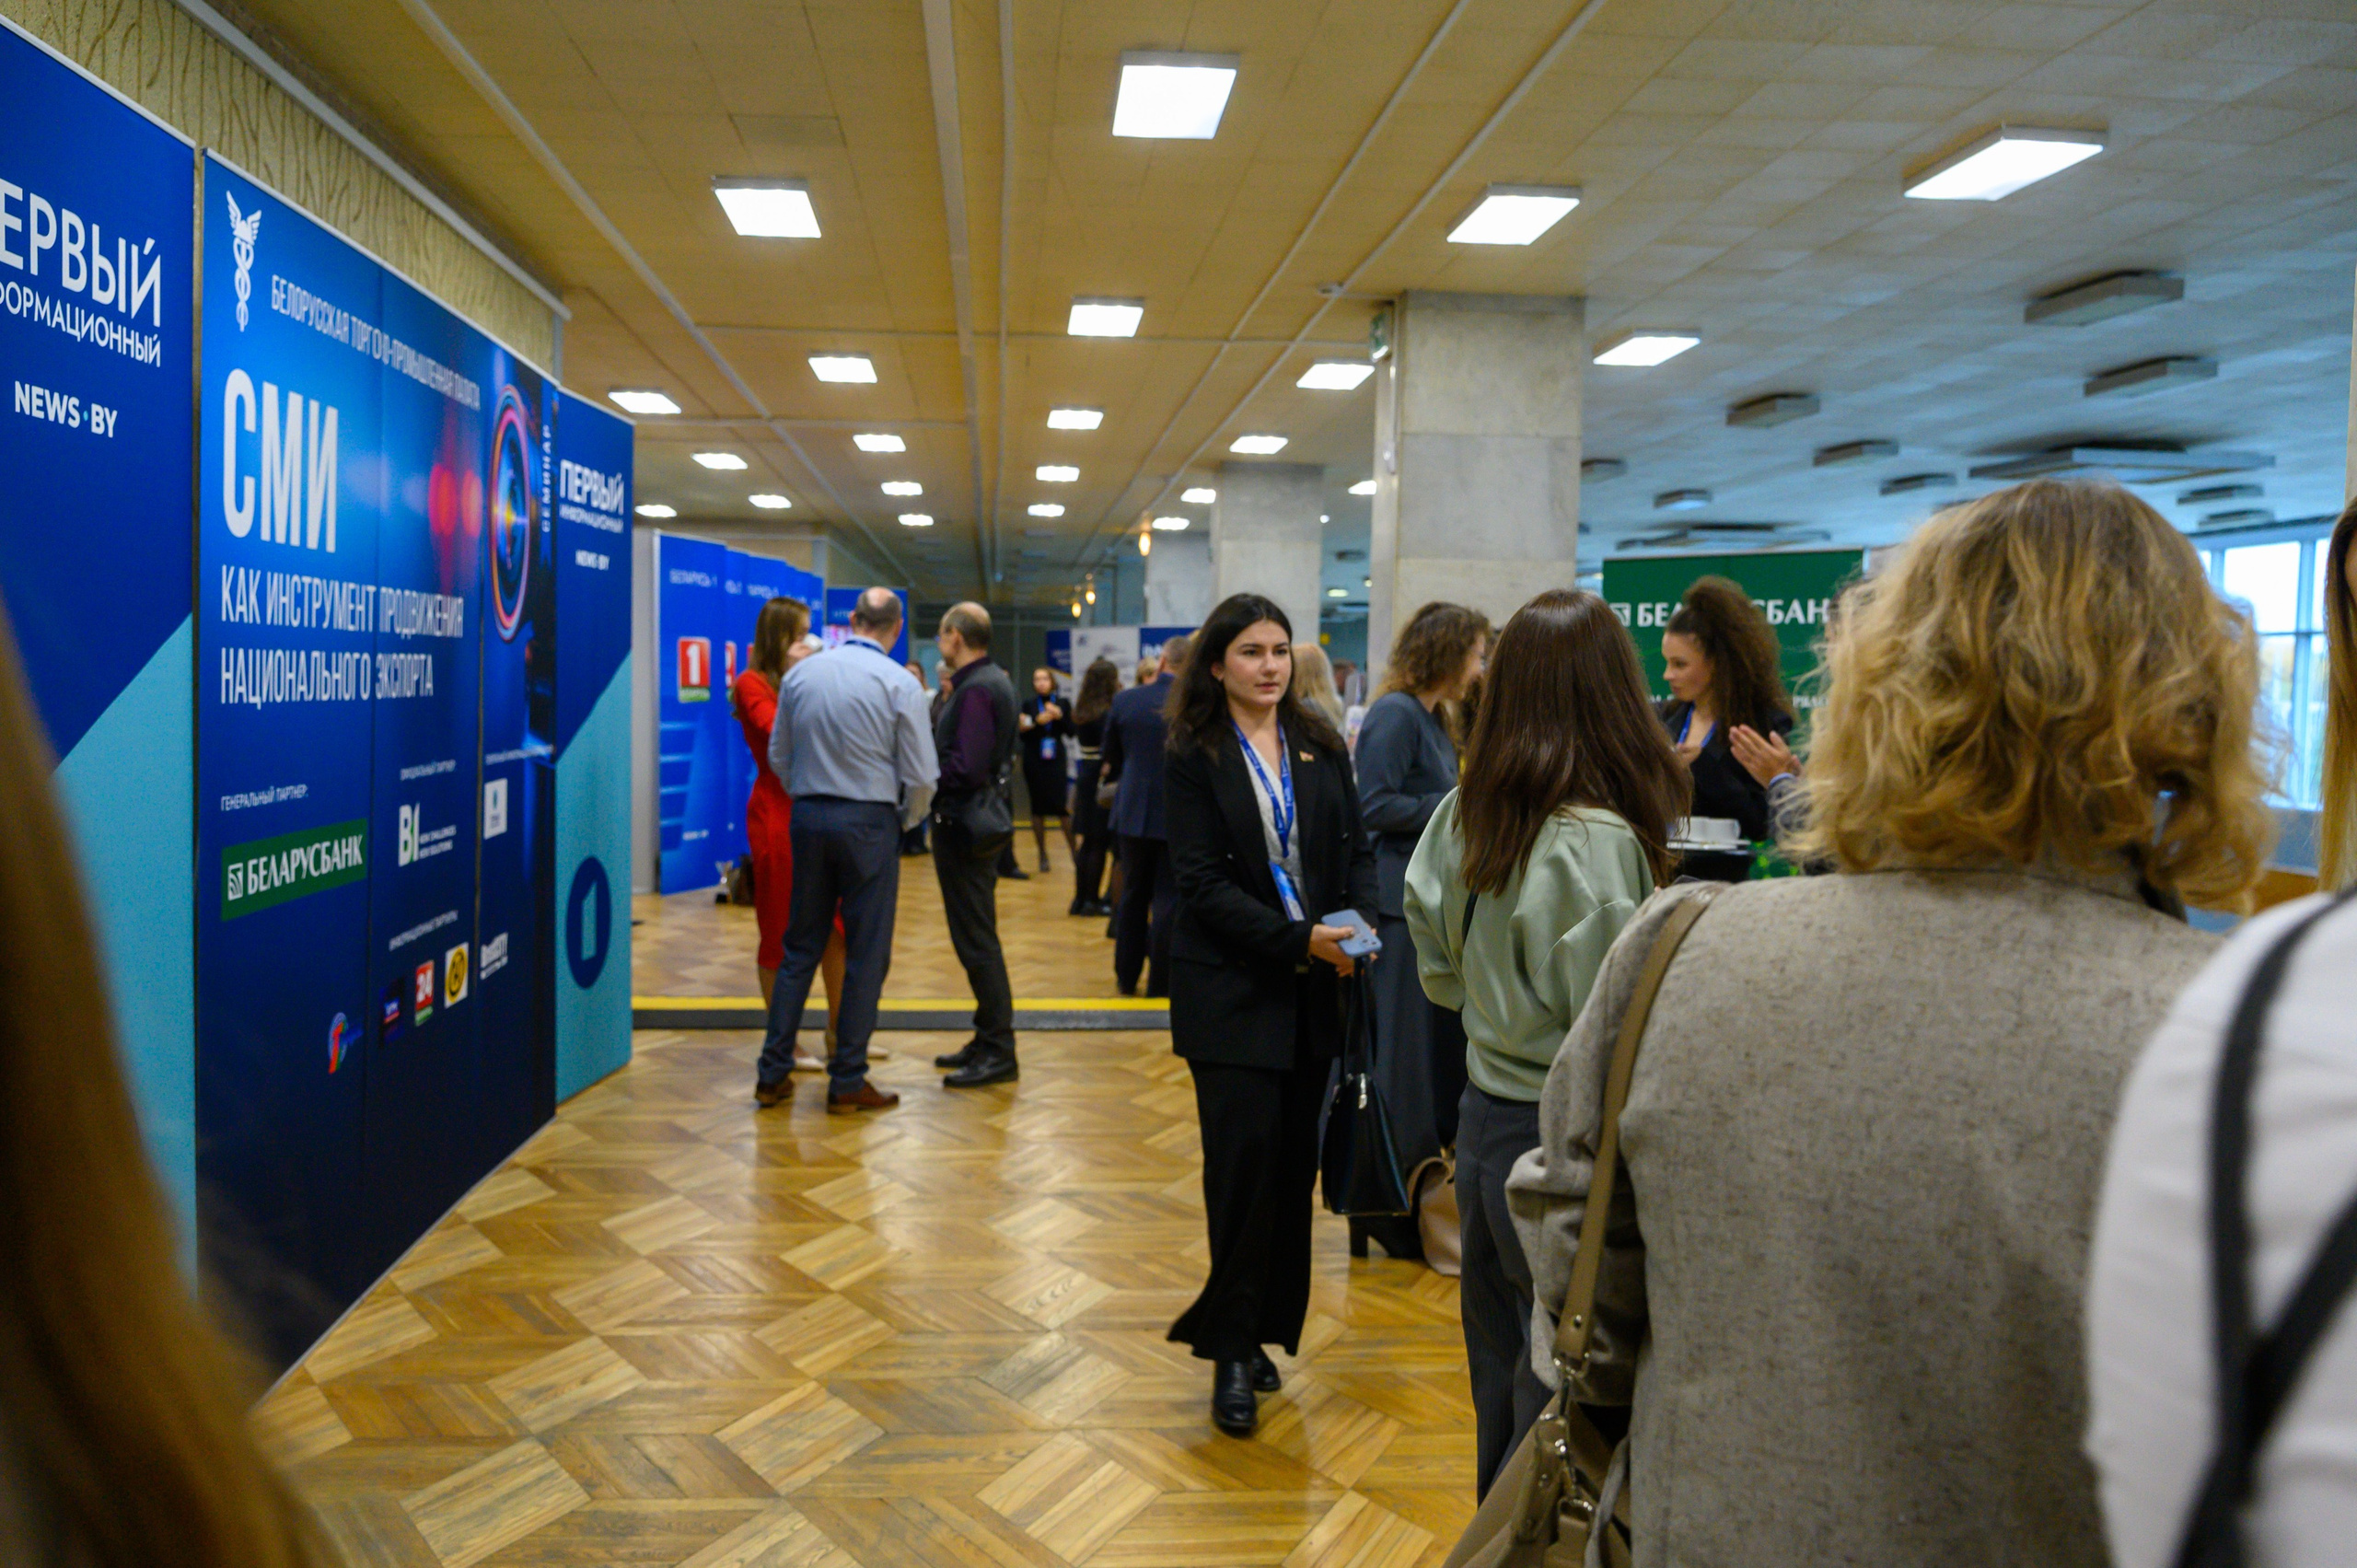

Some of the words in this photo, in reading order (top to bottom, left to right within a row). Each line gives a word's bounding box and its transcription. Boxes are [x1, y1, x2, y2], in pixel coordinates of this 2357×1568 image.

[223, 367, 339, 553] СМИ
[559, 459, 624, 516] ПЕРВЫЙ
[221, 564, 261, 624] КАК
[266, 571, 377, 633] ИНСТРУМЕНТ
[378, 586, 464, 639] ПРОДВИЖЕНИЯ
[221, 646, 371, 711] НАЦИОНАЛЬНОГО
[375, 652, 434, 700] ЭКСПОРТА
[687, 644, 701, 685] 1
[247, 834, 363, 896] БЕЛАРУСБАНК
